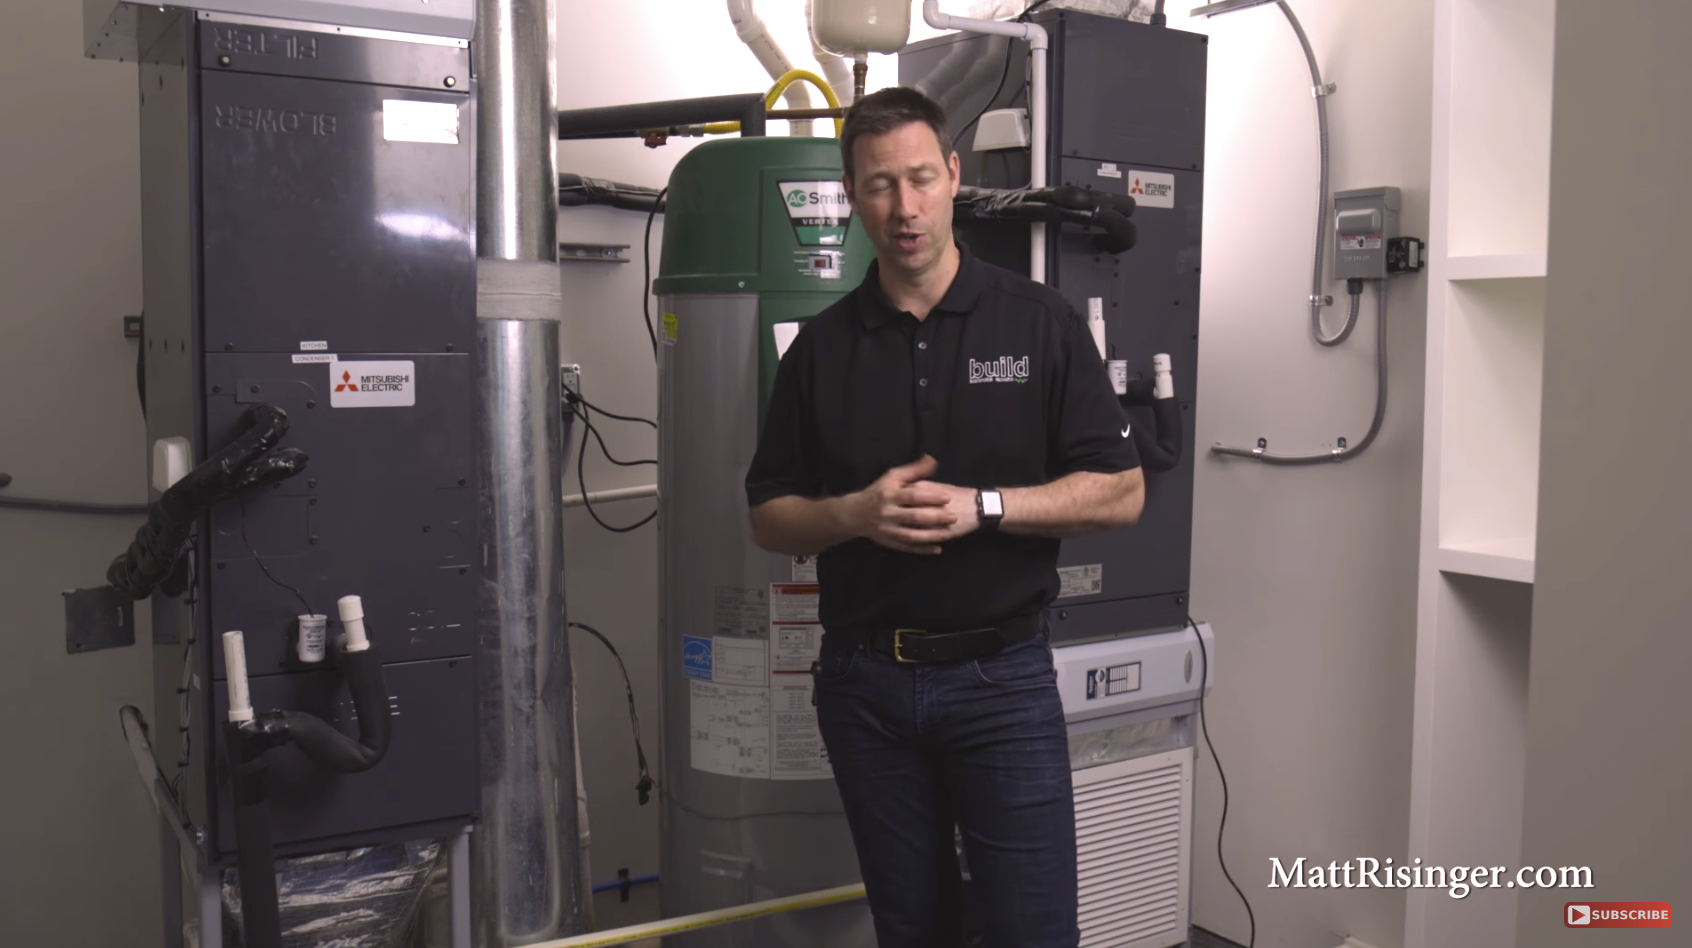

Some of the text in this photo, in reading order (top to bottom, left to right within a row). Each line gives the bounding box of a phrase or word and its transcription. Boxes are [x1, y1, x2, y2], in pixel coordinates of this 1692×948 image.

[213, 27, 318, 59] FILTER
[214, 104, 338, 136] BLOWER
[1144, 182, 1172, 191] MITSUBISHI
[1144, 189, 1168, 197] ELECTRIC
[969, 355, 1029, 379] build
[361, 375, 409, 384] MITSUBISHI
[361, 383, 403, 392] ELECTRIC
